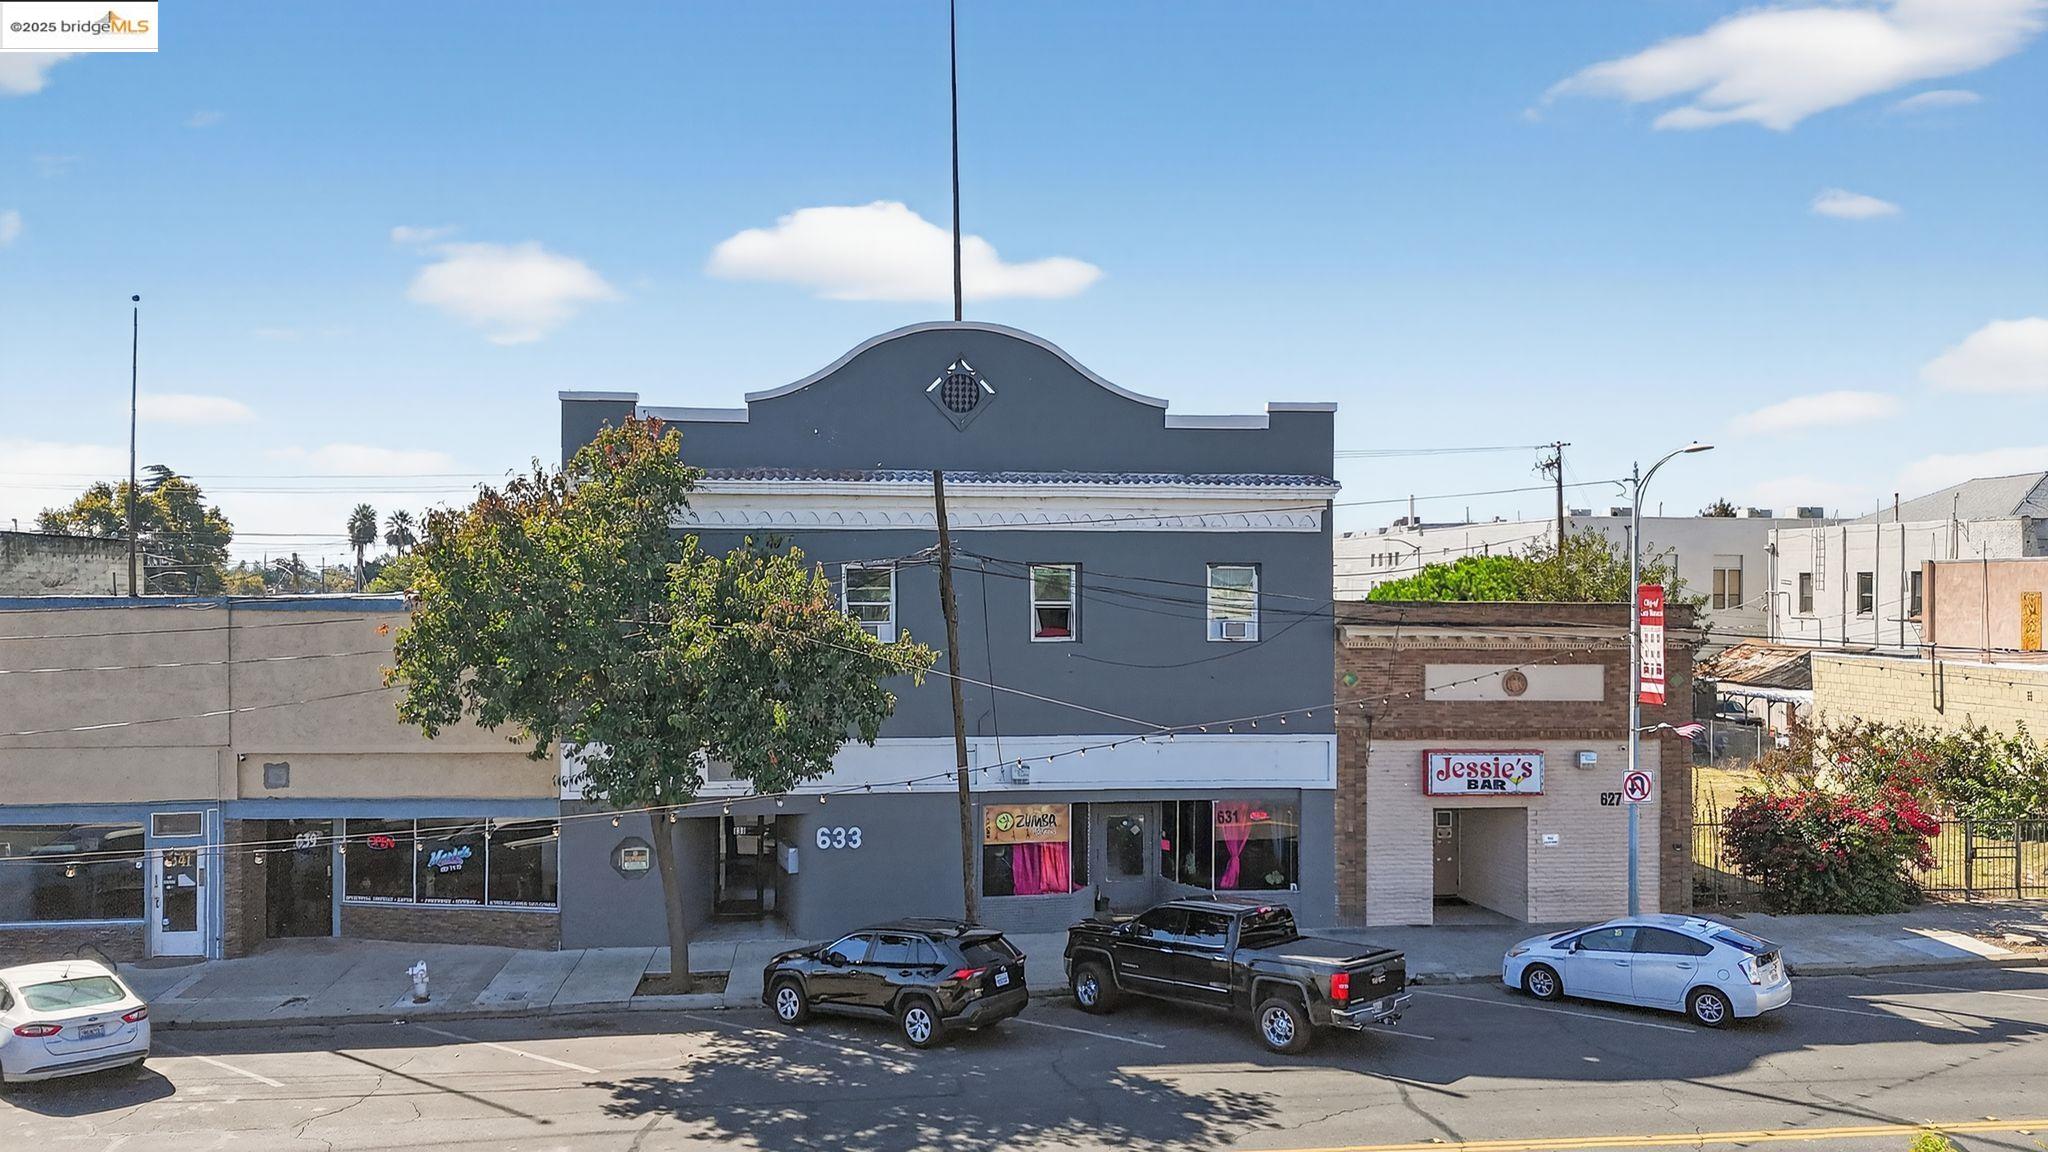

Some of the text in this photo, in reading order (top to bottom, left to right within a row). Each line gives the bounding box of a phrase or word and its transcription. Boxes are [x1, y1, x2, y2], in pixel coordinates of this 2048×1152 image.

[1436, 756, 1533, 782] Jessie's
[1467, 779, 1507, 791] BAR
[1600, 792, 1623, 806] 627
[1015, 813, 1057, 828] ZUMBA
[1217, 810, 1239, 824] 631
[816, 826, 862, 850] 633
